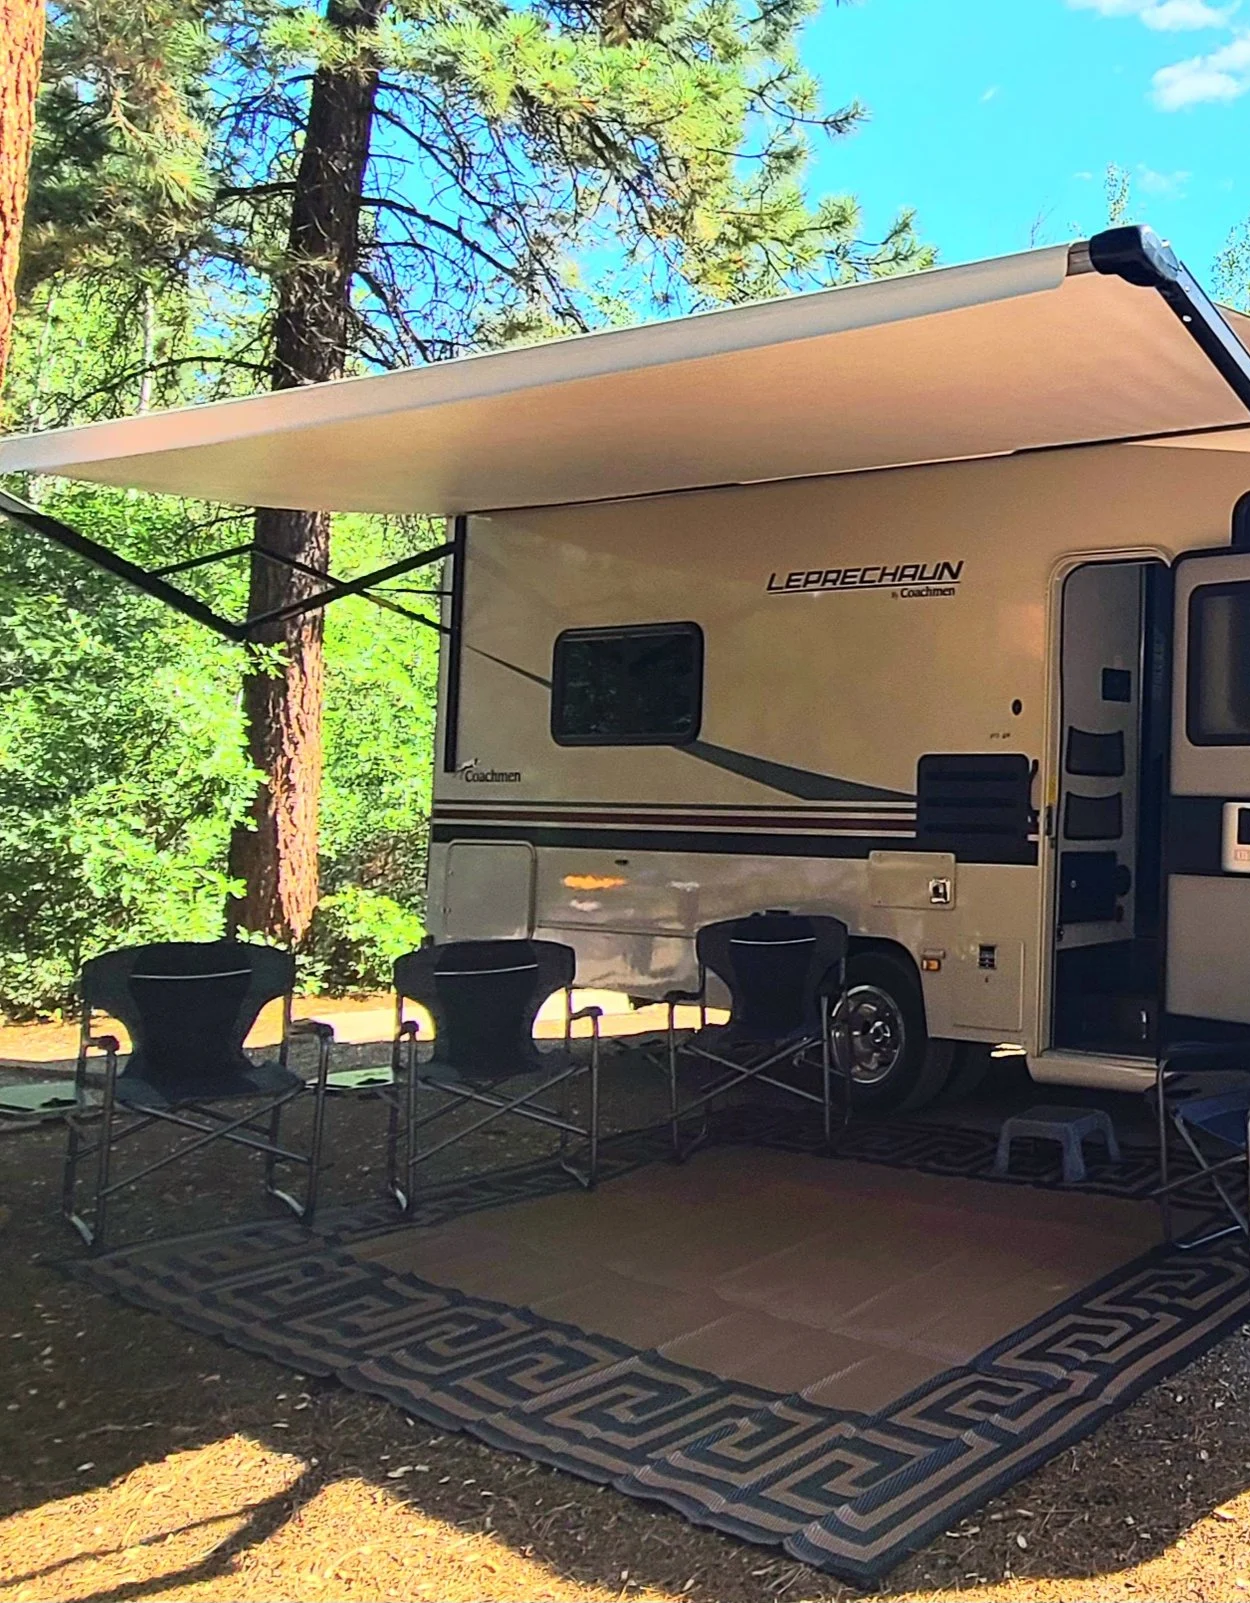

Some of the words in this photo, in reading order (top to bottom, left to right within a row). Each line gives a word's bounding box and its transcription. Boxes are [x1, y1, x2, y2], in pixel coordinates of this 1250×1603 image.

[766, 560, 964, 591] LEPRECHAUN
[900, 585, 955, 598] Coachmen
[464, 769, 521, 783] Coachmen
